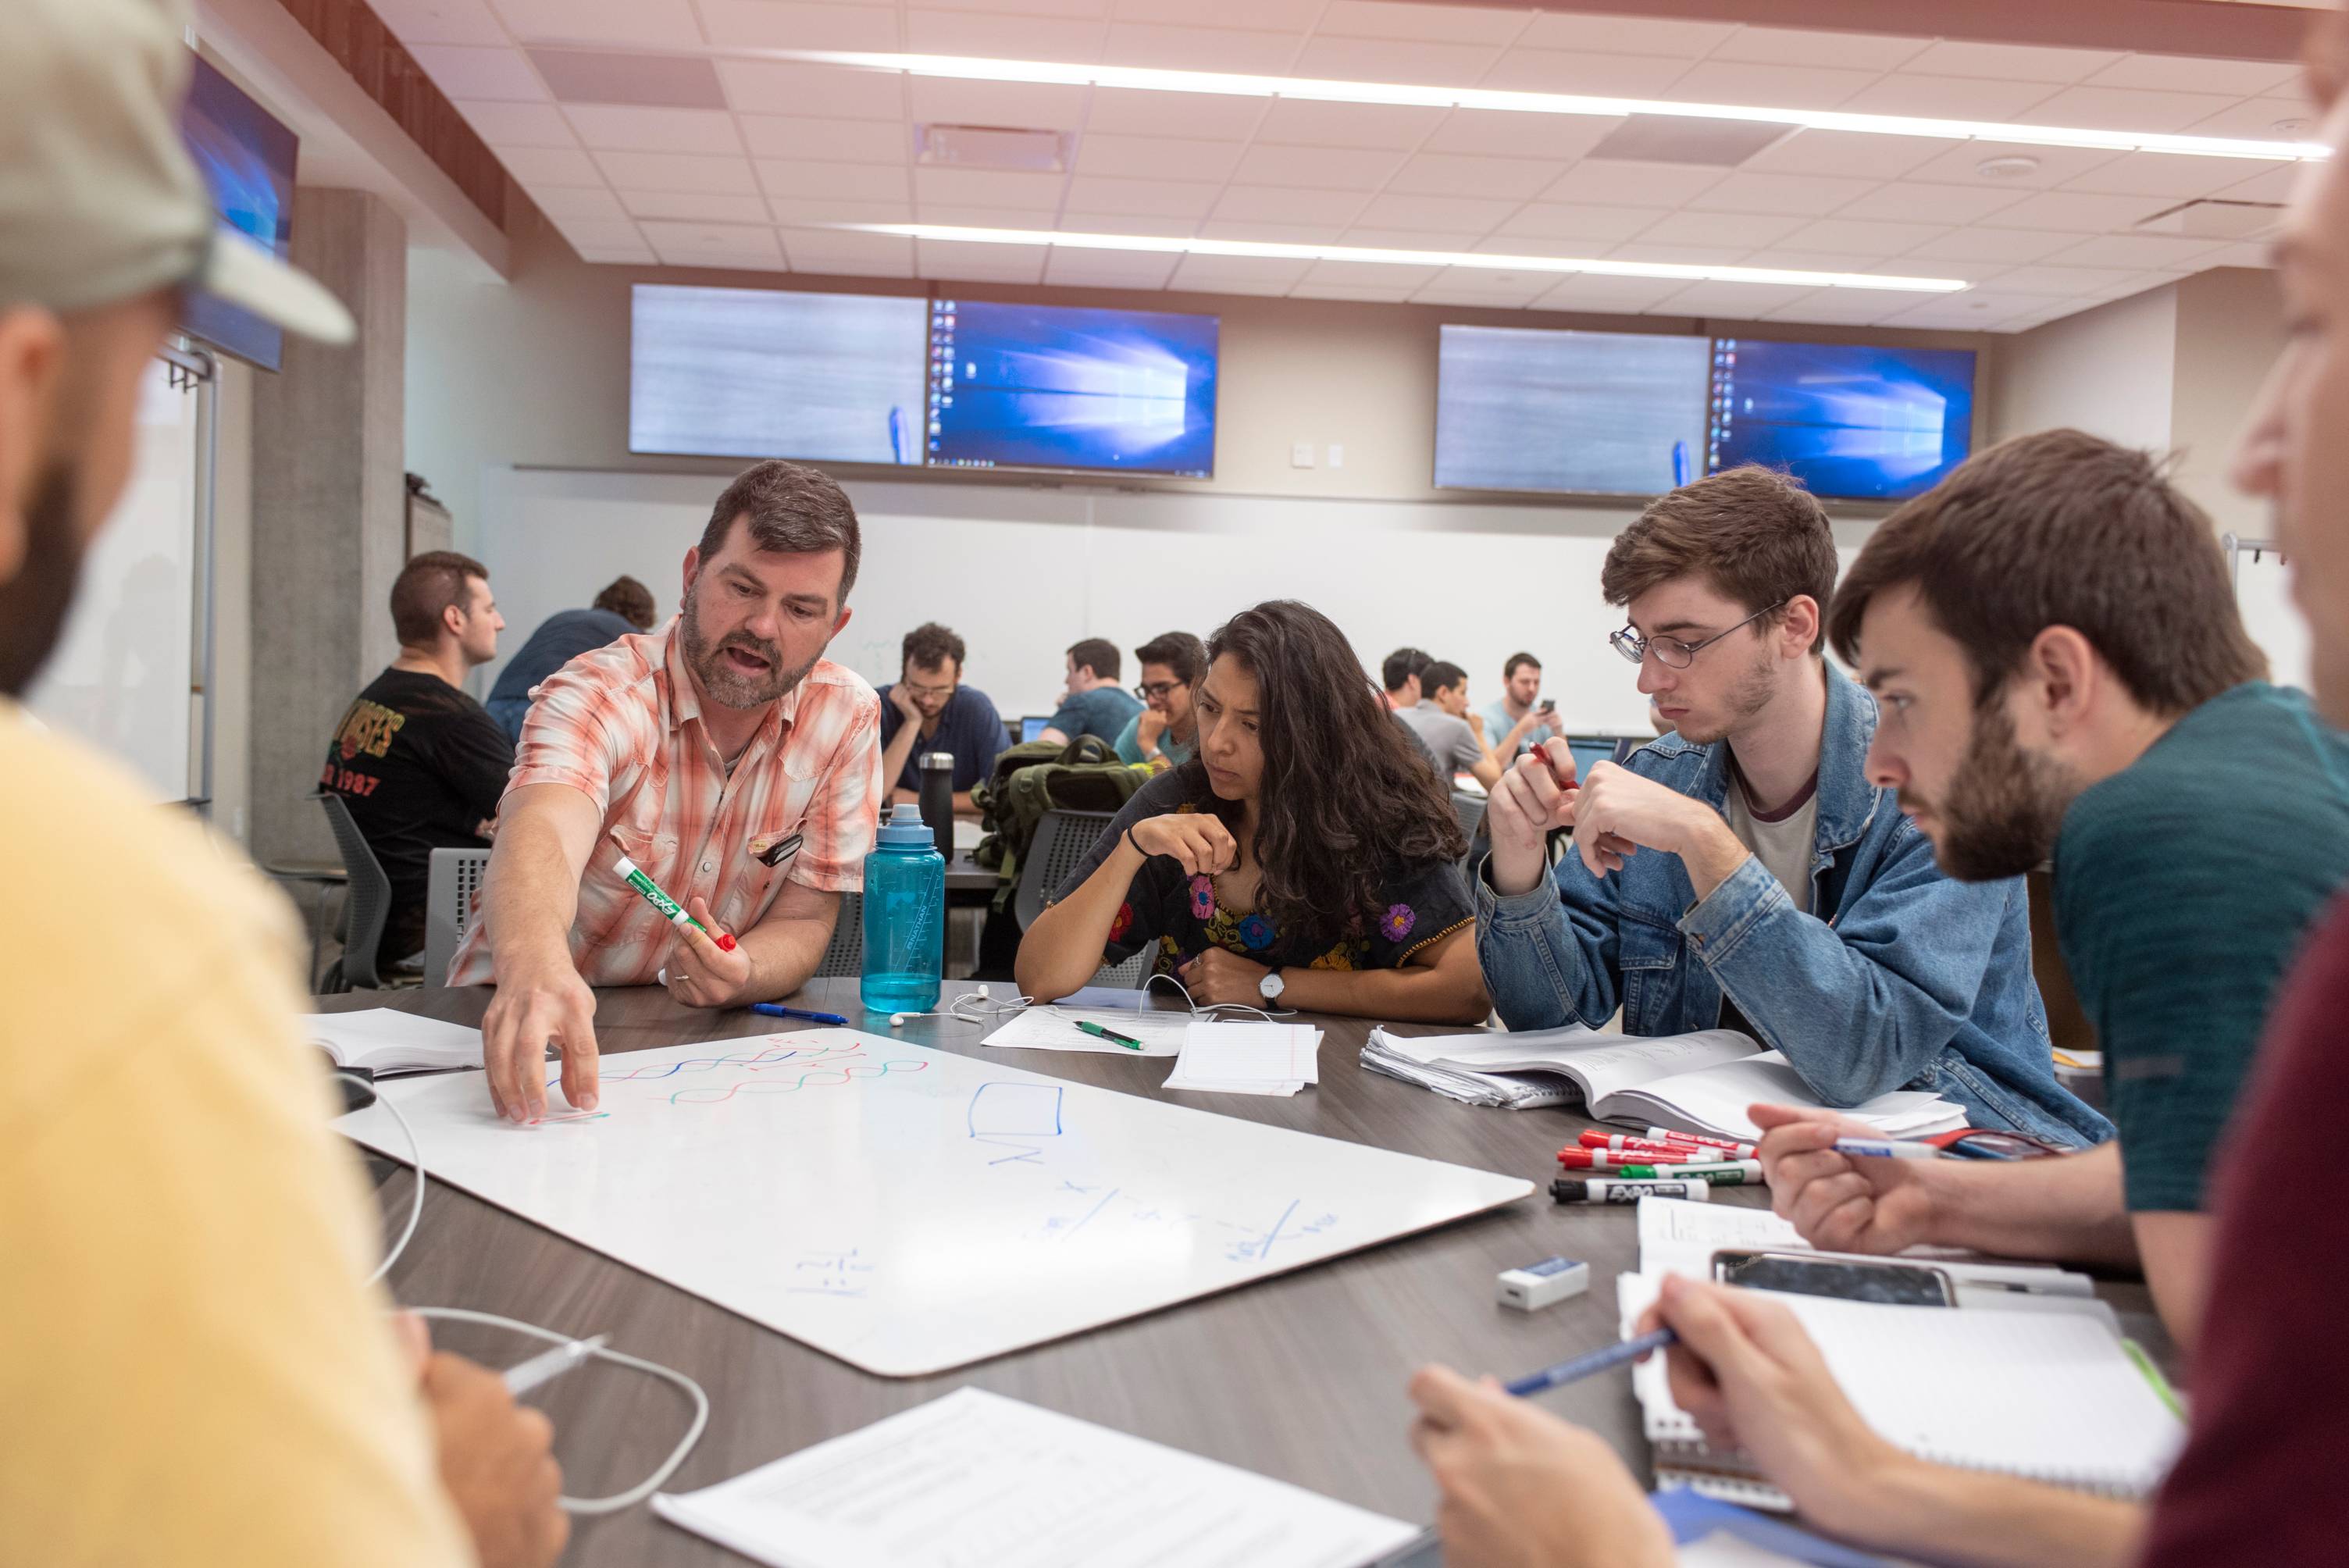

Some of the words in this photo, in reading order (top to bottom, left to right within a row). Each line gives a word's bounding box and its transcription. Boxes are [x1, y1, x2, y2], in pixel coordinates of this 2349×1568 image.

[337, 768, 381, 796] 1987
[647, 892, 677, 915] EXPO
[910, 906, 927, 943] NATHAN
[1609, 1185, 1654, 1202] EXPO
